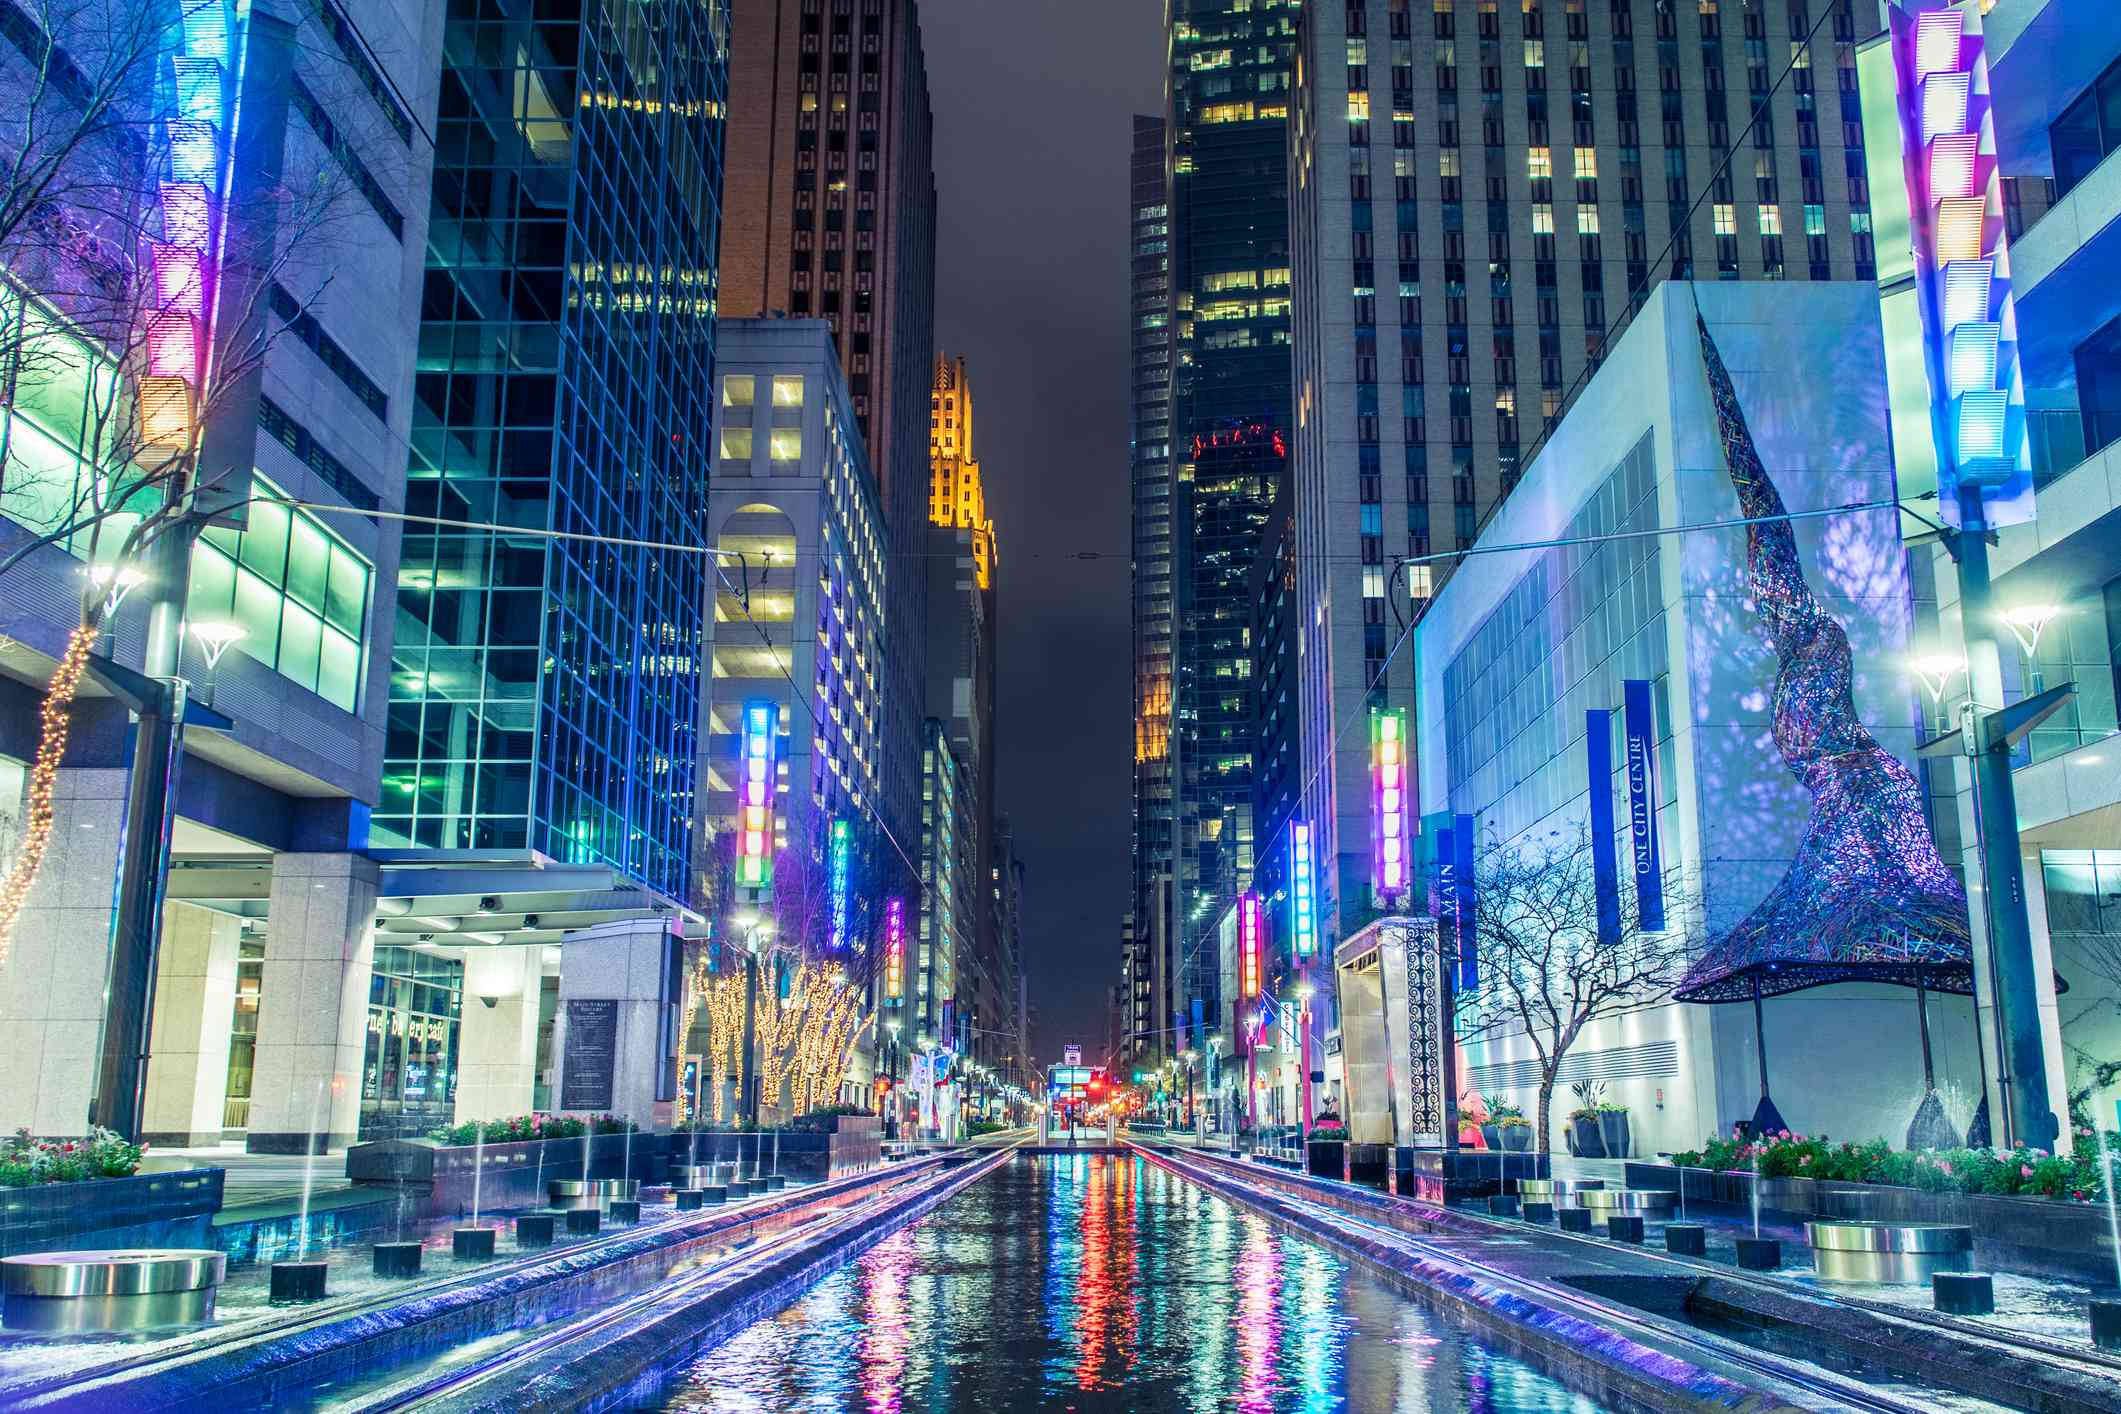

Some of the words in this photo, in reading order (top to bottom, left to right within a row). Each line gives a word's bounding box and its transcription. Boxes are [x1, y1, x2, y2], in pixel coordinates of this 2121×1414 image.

[1629, 734, 1644, 793] CENTRE
[1634, 800, 1647, 836] CITY
[1636, 841, 1650, 874] ONE
[1440, 864, 1456, 917] MAIN
